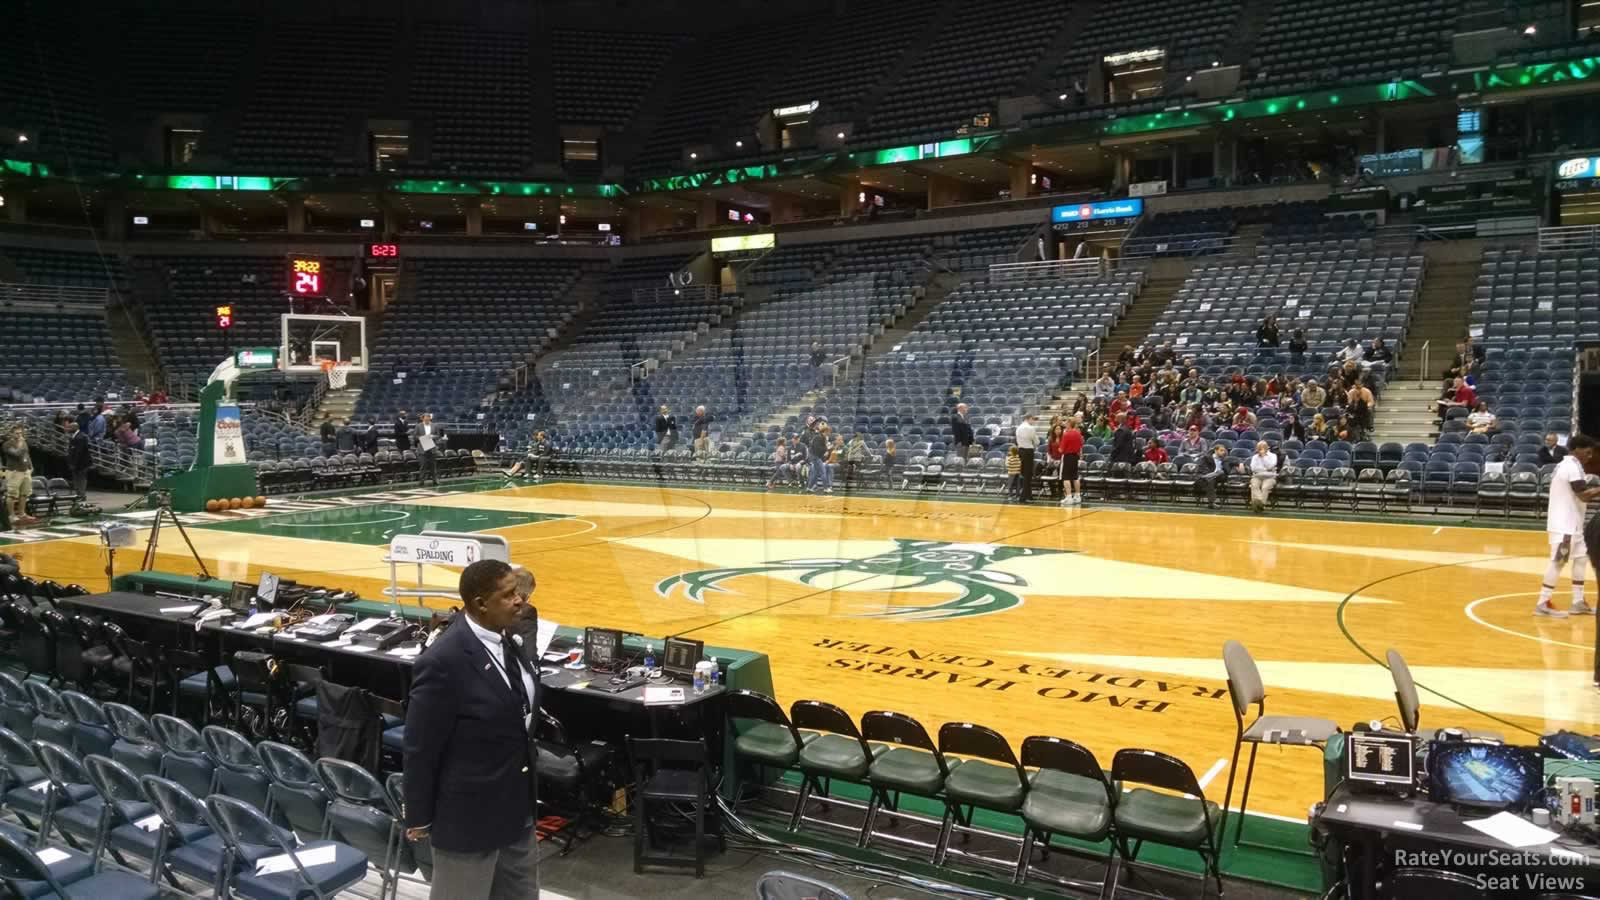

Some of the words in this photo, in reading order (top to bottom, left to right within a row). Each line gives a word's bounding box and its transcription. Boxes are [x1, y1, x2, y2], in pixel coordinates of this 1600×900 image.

[372, 245, 397, 256] 6:23
[296, 273, 318, 293] 24
[416, 548, 454, 562] SPALDING
[813, 638, 995, 668] CENTER
[827, 658, 1018, 691] HARRIS
[1000, 663, 1256, 700] RADLEY
[1037, 687, 1173, 713] BMO
